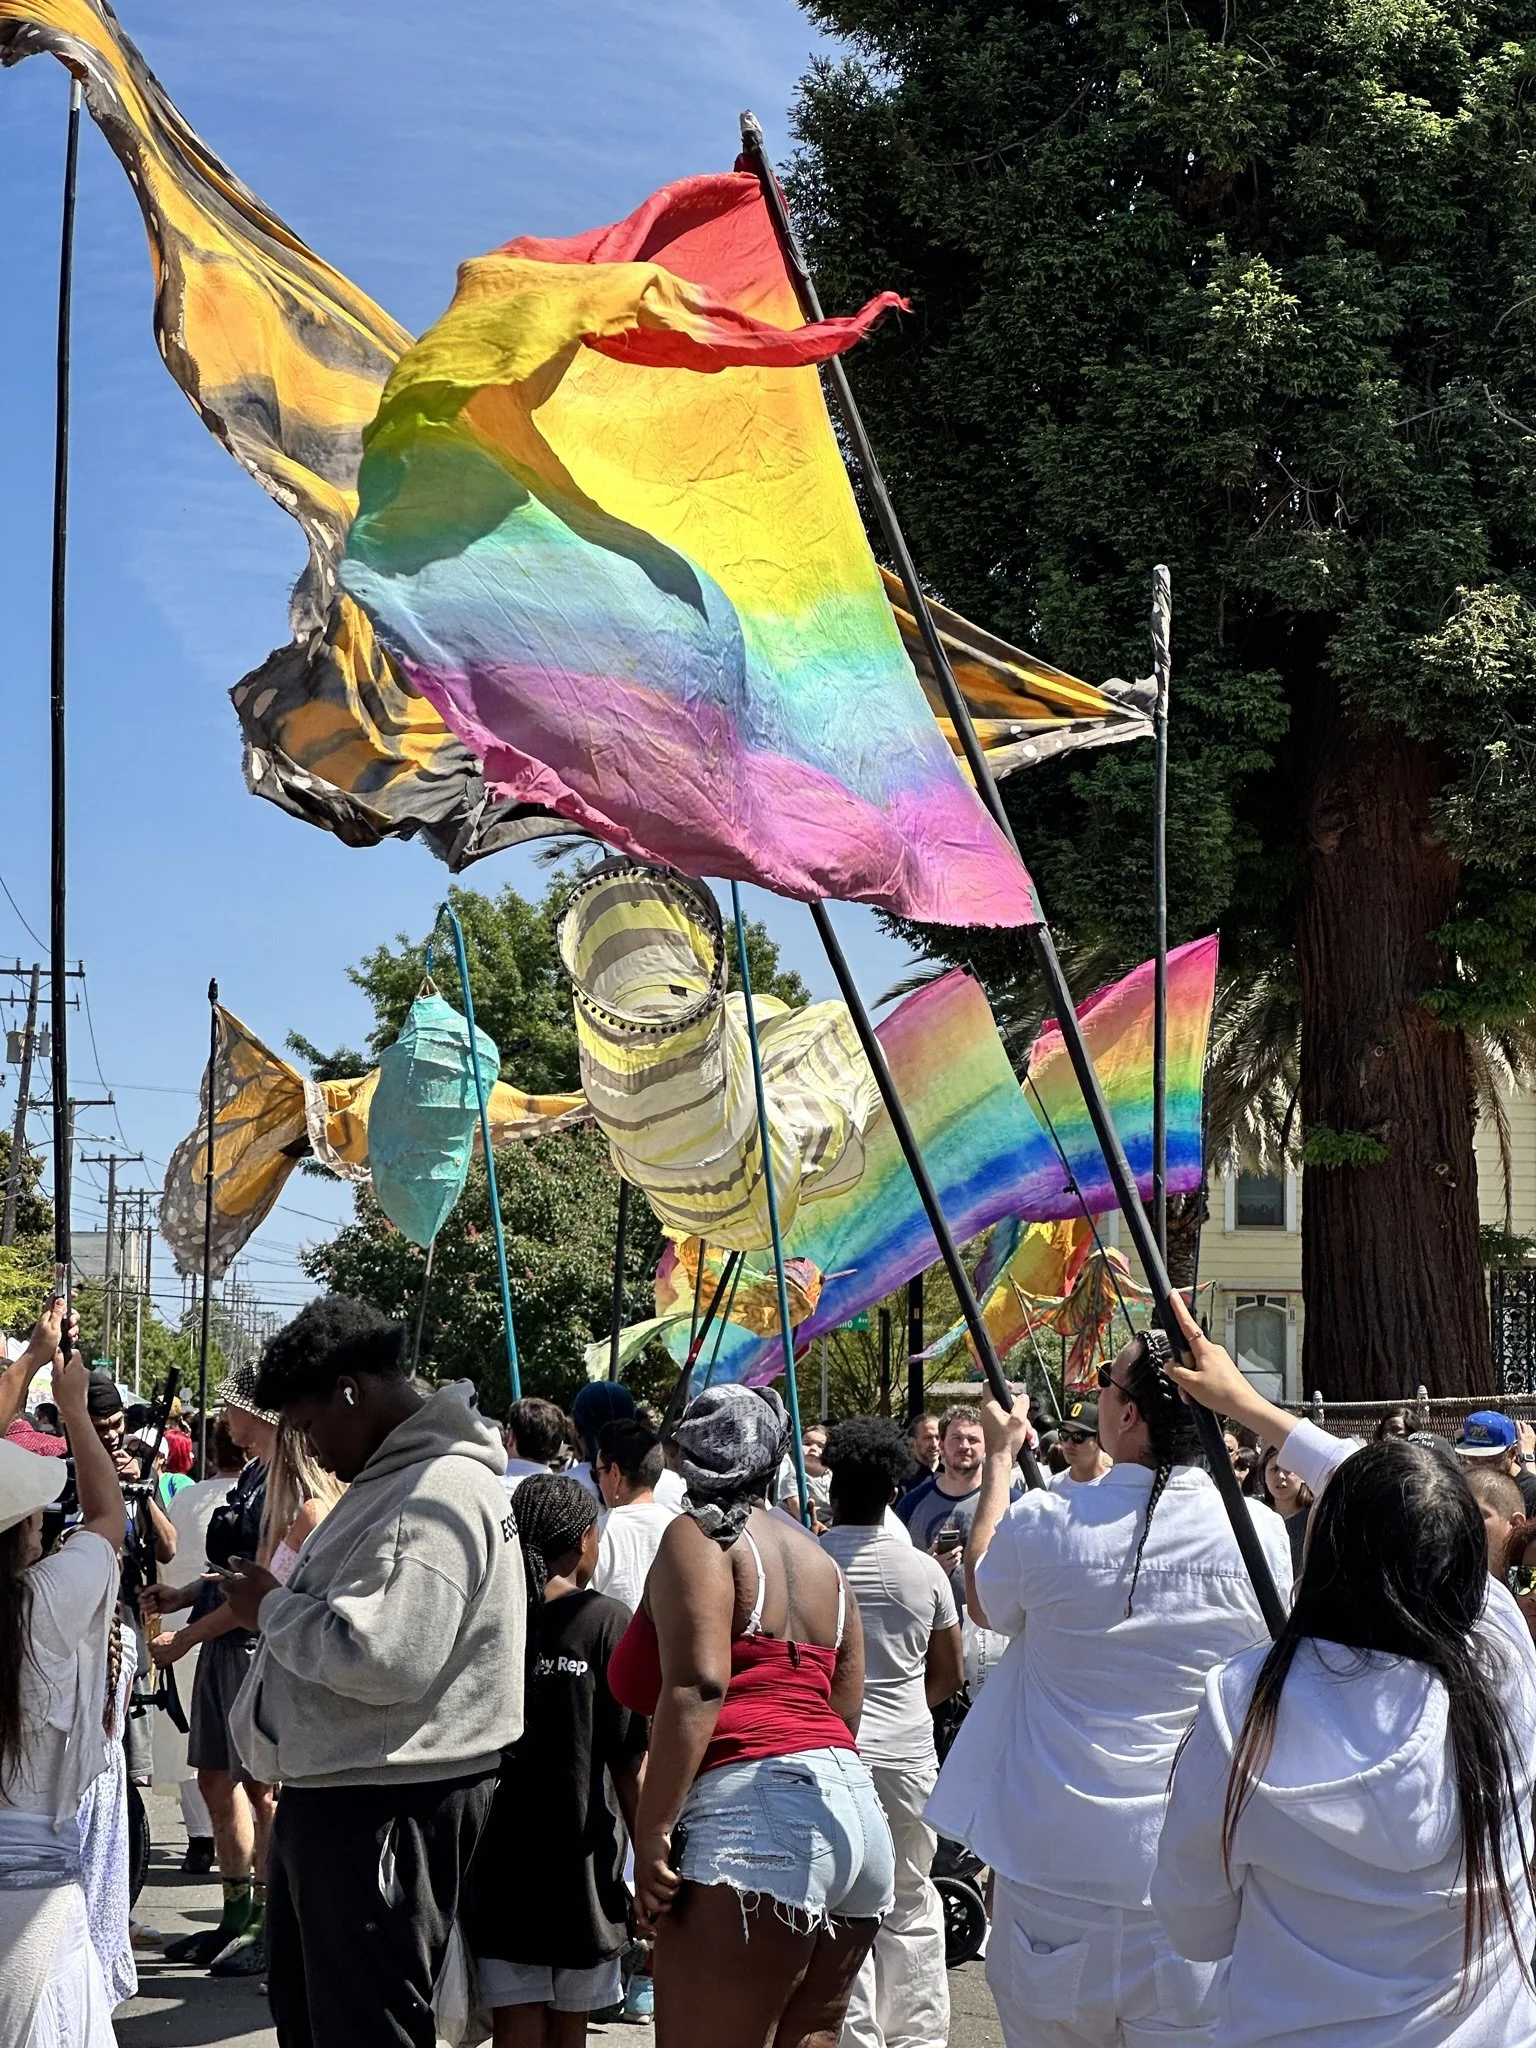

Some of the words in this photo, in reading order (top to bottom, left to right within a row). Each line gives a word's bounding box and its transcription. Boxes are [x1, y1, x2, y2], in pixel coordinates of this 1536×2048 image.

[1070, 1402, 1083, 1418] O
[977, 1629, 986, 1665] CATER
[557, 1656, 588, 1677] Rep
[977, 1668, 986, 1685] WE
